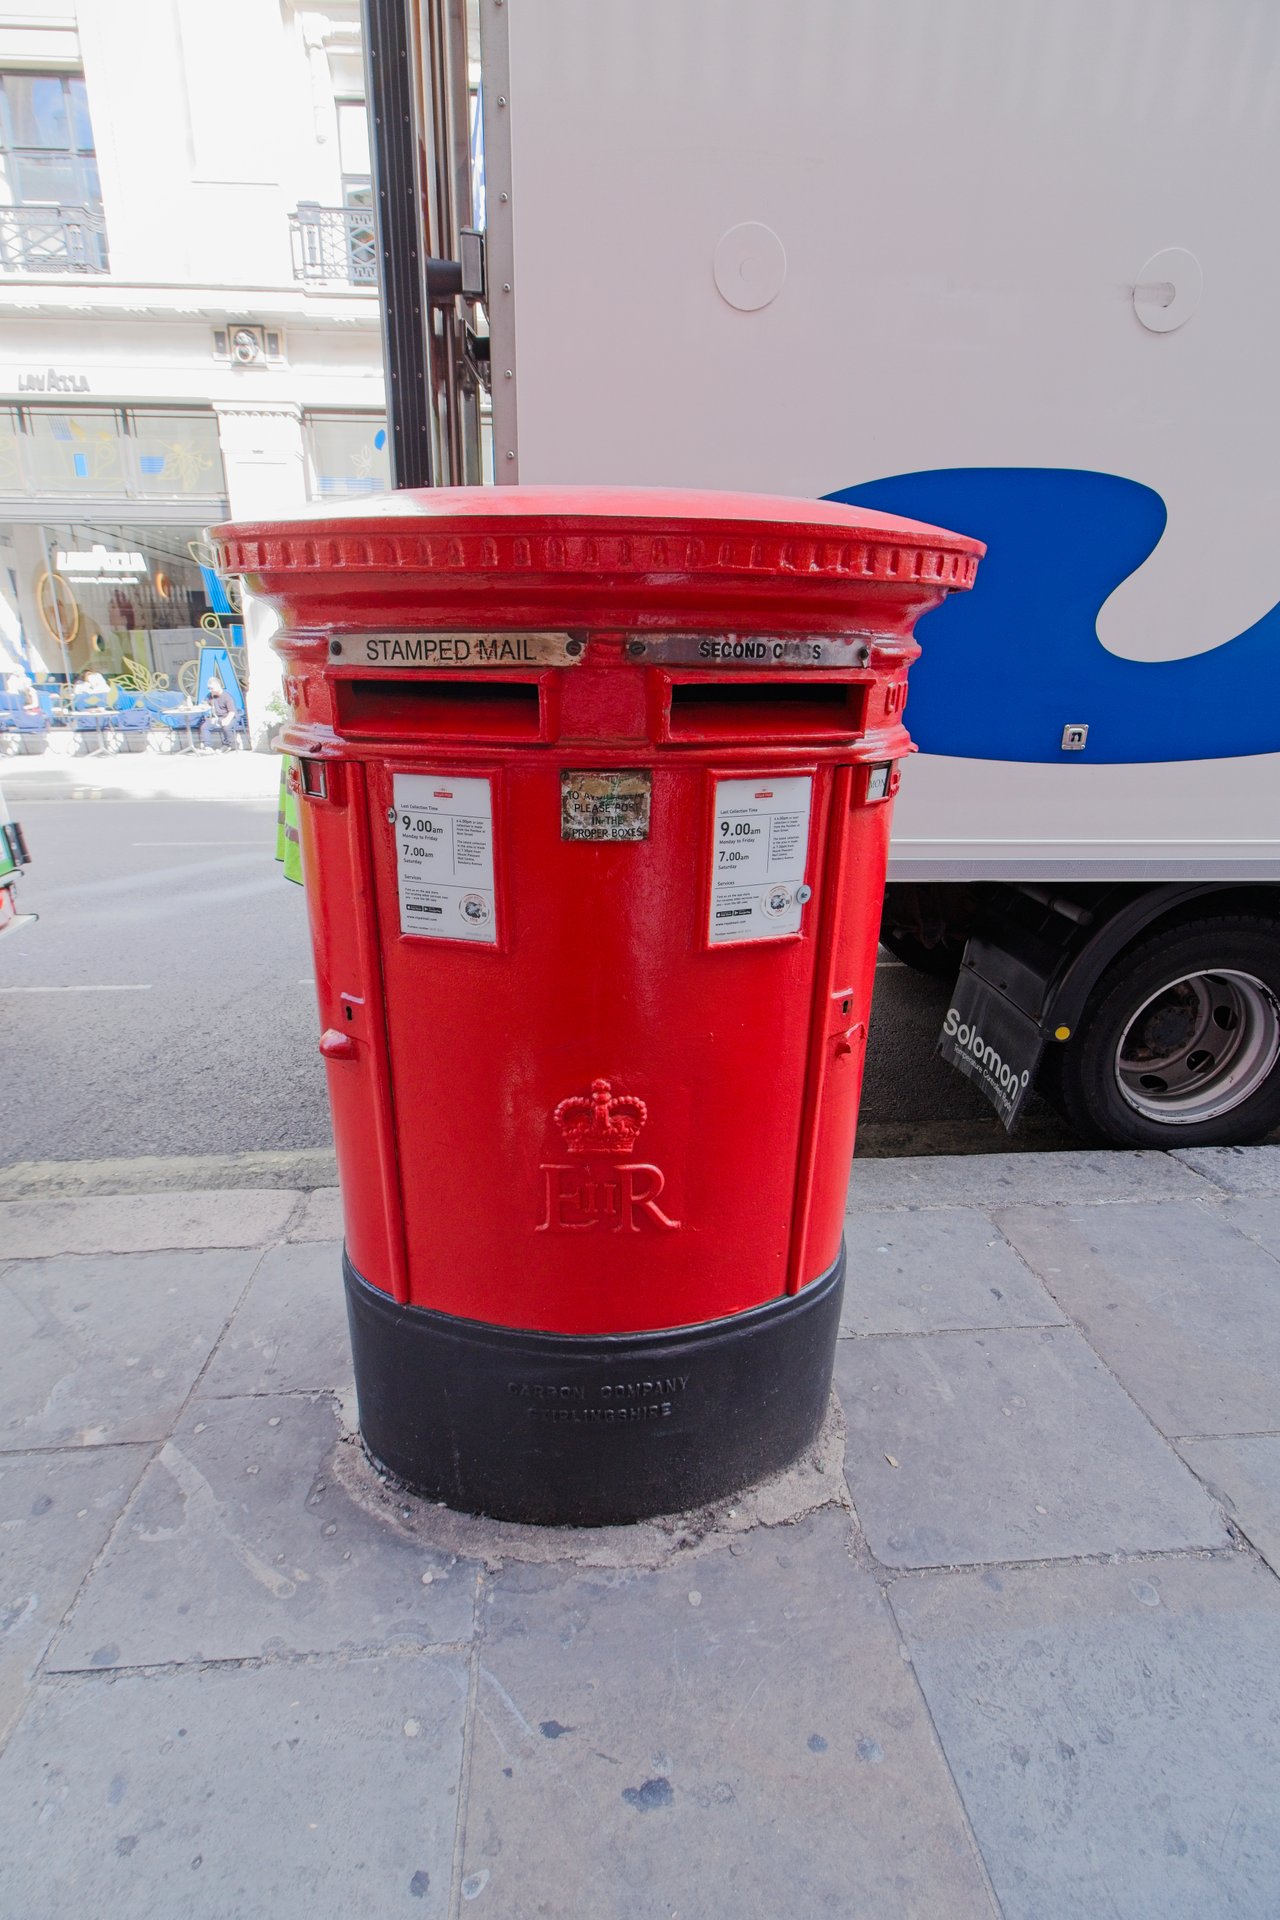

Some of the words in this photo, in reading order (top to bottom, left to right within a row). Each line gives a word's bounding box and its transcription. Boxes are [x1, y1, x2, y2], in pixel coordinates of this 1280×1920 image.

[366, 639, 471, 661] STAMPED
[478, 640, 537, 661] MAIL
[699, 641, 767, 659] SECOND
[574, 804, 611, 813] PLEASE
[402, 815, 444, 833] 9.00am
[592, 816, 602, 825] IN
[572, 828, 609, 838] PROPER
[611, 827, 643, 837] BOXES
[720, 821, 761, 837] 9.00am
[403, 844, 434, 858] 7.00am
[719, 851, 750, 862] 7.00am
[600, 1376, 689, 1399] COMPANY
